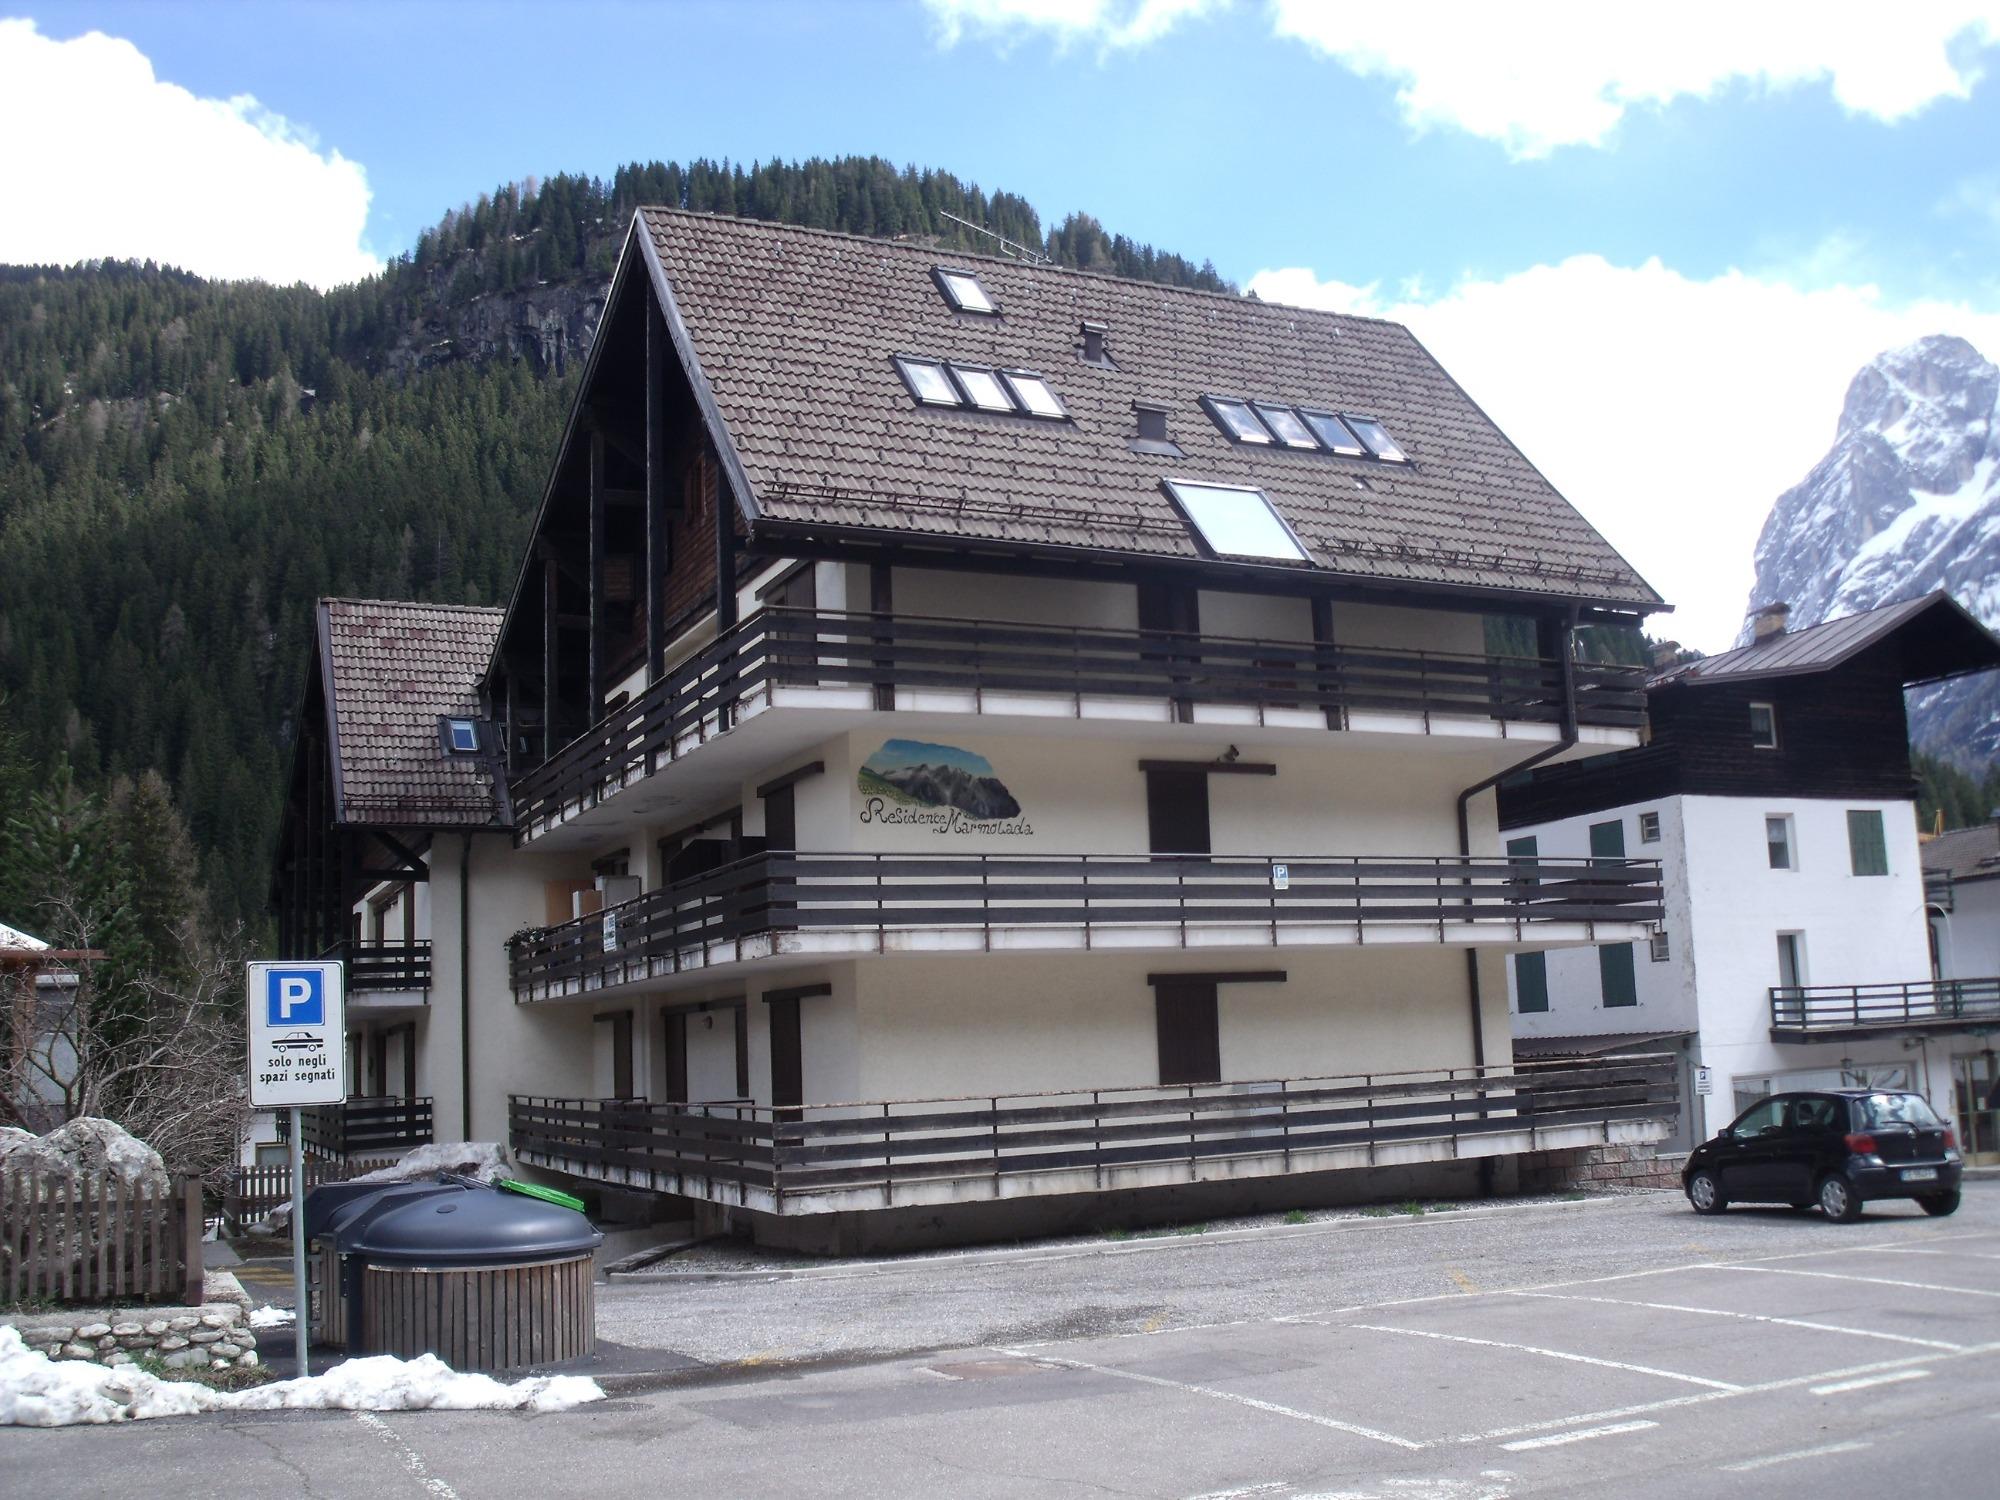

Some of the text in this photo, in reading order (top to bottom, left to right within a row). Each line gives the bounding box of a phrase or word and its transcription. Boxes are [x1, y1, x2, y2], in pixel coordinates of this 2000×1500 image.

[1277, 867, 1285, 878] P
[280, 977, 312, 1019] P
[268, 1054, 327, 1069] solo negli
[259, 1068, 335, 1085] spazi segnati
